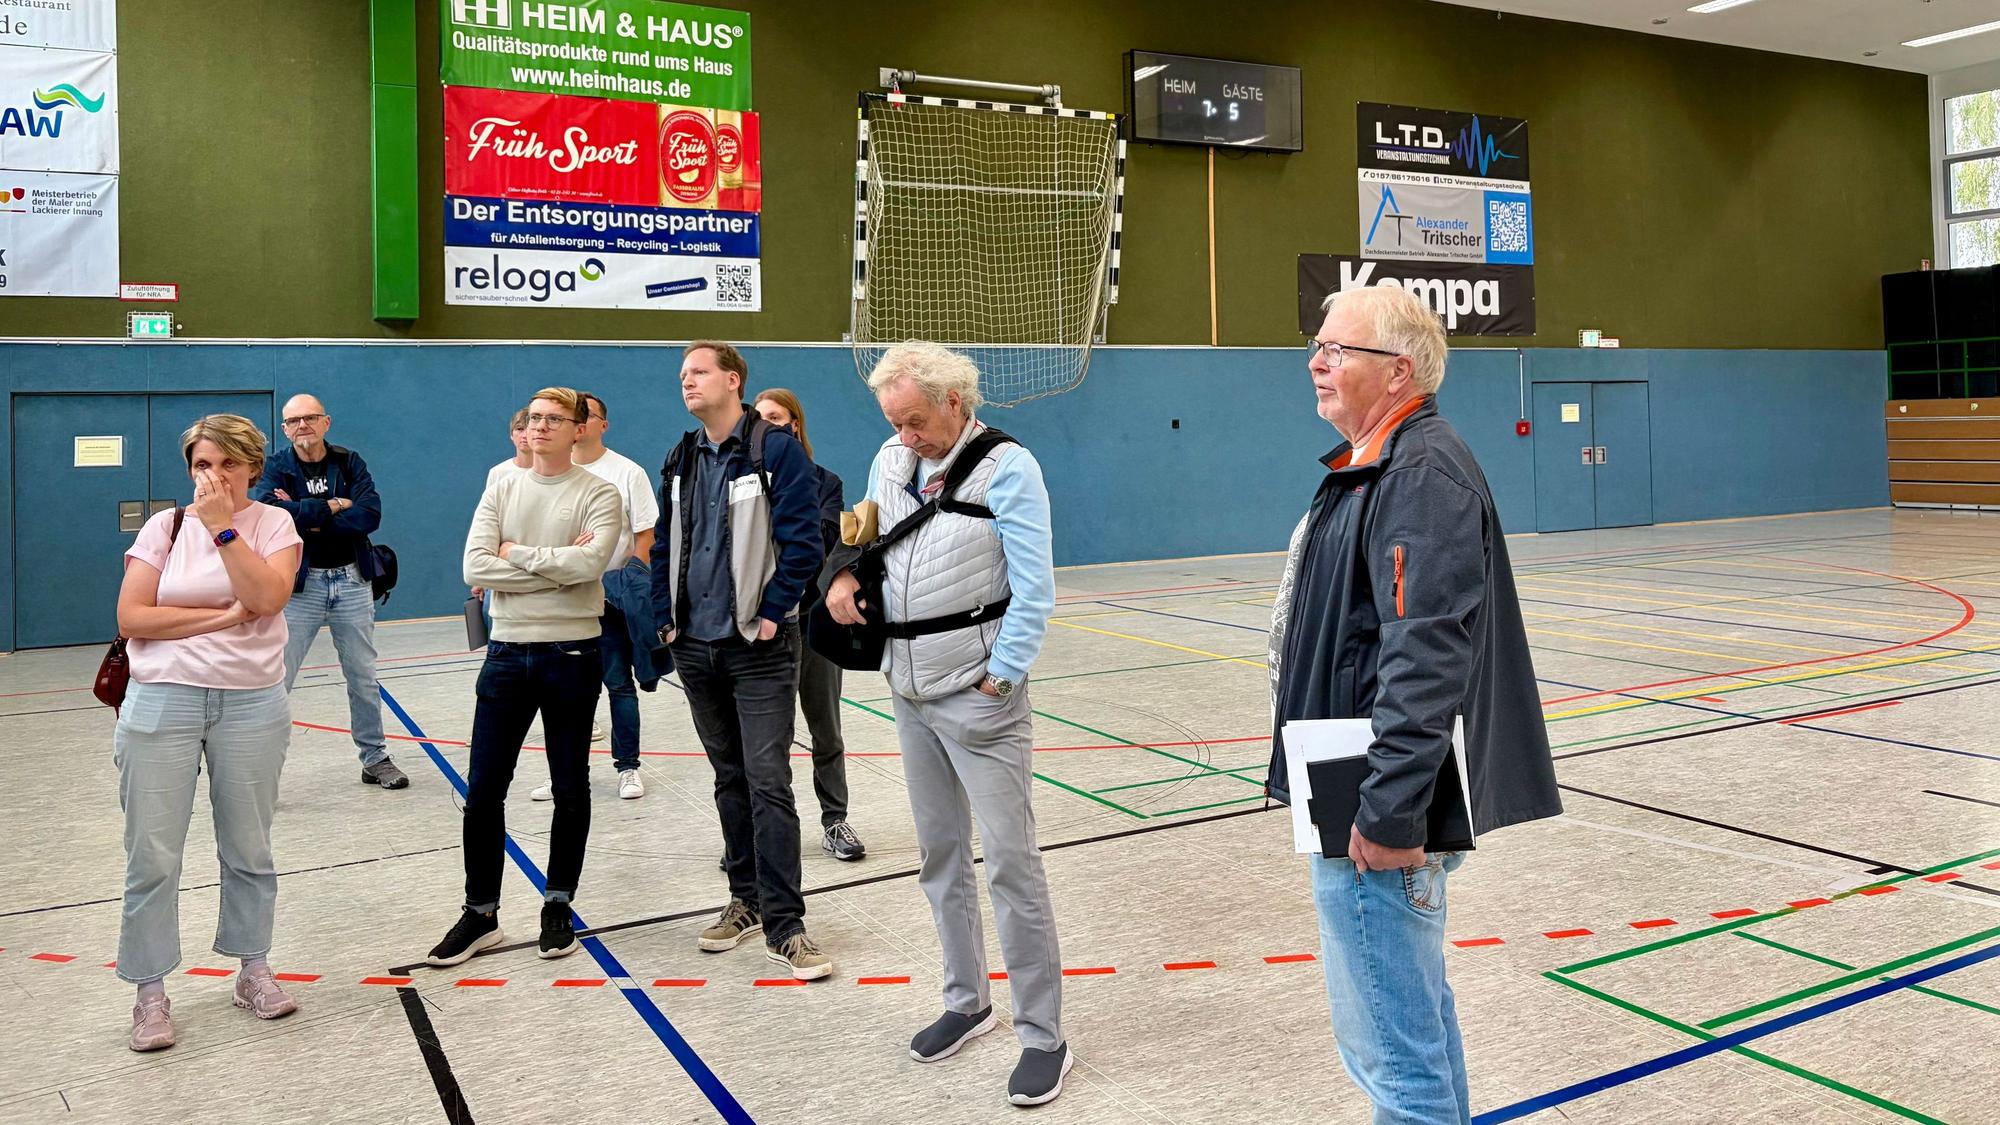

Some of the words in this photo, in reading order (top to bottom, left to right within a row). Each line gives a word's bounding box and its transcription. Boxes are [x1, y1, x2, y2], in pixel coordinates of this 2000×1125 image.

[522, 2, 606, 34] HEIM
[616, 12, 638, 38] &
[452, 31, 607, 62] Qualitätsprodukte
[612, 51, 650, 67] rund
[655, 55, 689, 71] ums
[693, 56, 733, 76] Haus
[511, 67, 691, 98] www.heimhaus.de
[1164, 78, 1196, 95] HEIM
[1222, 84, 1263, 101] GÄSTE
[467, 117, 549, 161] Früh
[548, 126, 638, 173] Sport
[669, 132, 708, 155] Früh
[1376, 121, 1450, 149] L.T.D.
[669, 150, 708, 170] Sport
[32, 189, 97, 199] Meisterbetrieb
[32, 198, 46, 206] der
[49, 199, 73, 207] Maler
[76, 199, 92, 207] und
[32, 206, 70, 215] Lackierer
[73, 207, 103, 217] Innung
[453, 198, 499, 223] Der
[507, 200, 753, 234] Entsorgungspartner
[1416, 216, 1468, 230] Alexander
[491, 232, 508, 244] für
[509, 233, 604, 249] Abfallentsorgung
[617, 238, 668, 252] Recycling
[680, 240, 721, 252] Logistik
[1422, 229, 1482, 247] Tritscher
[455, 254, 576, 302] reloga
[1340, 261, 1500, 329] Kmpa
